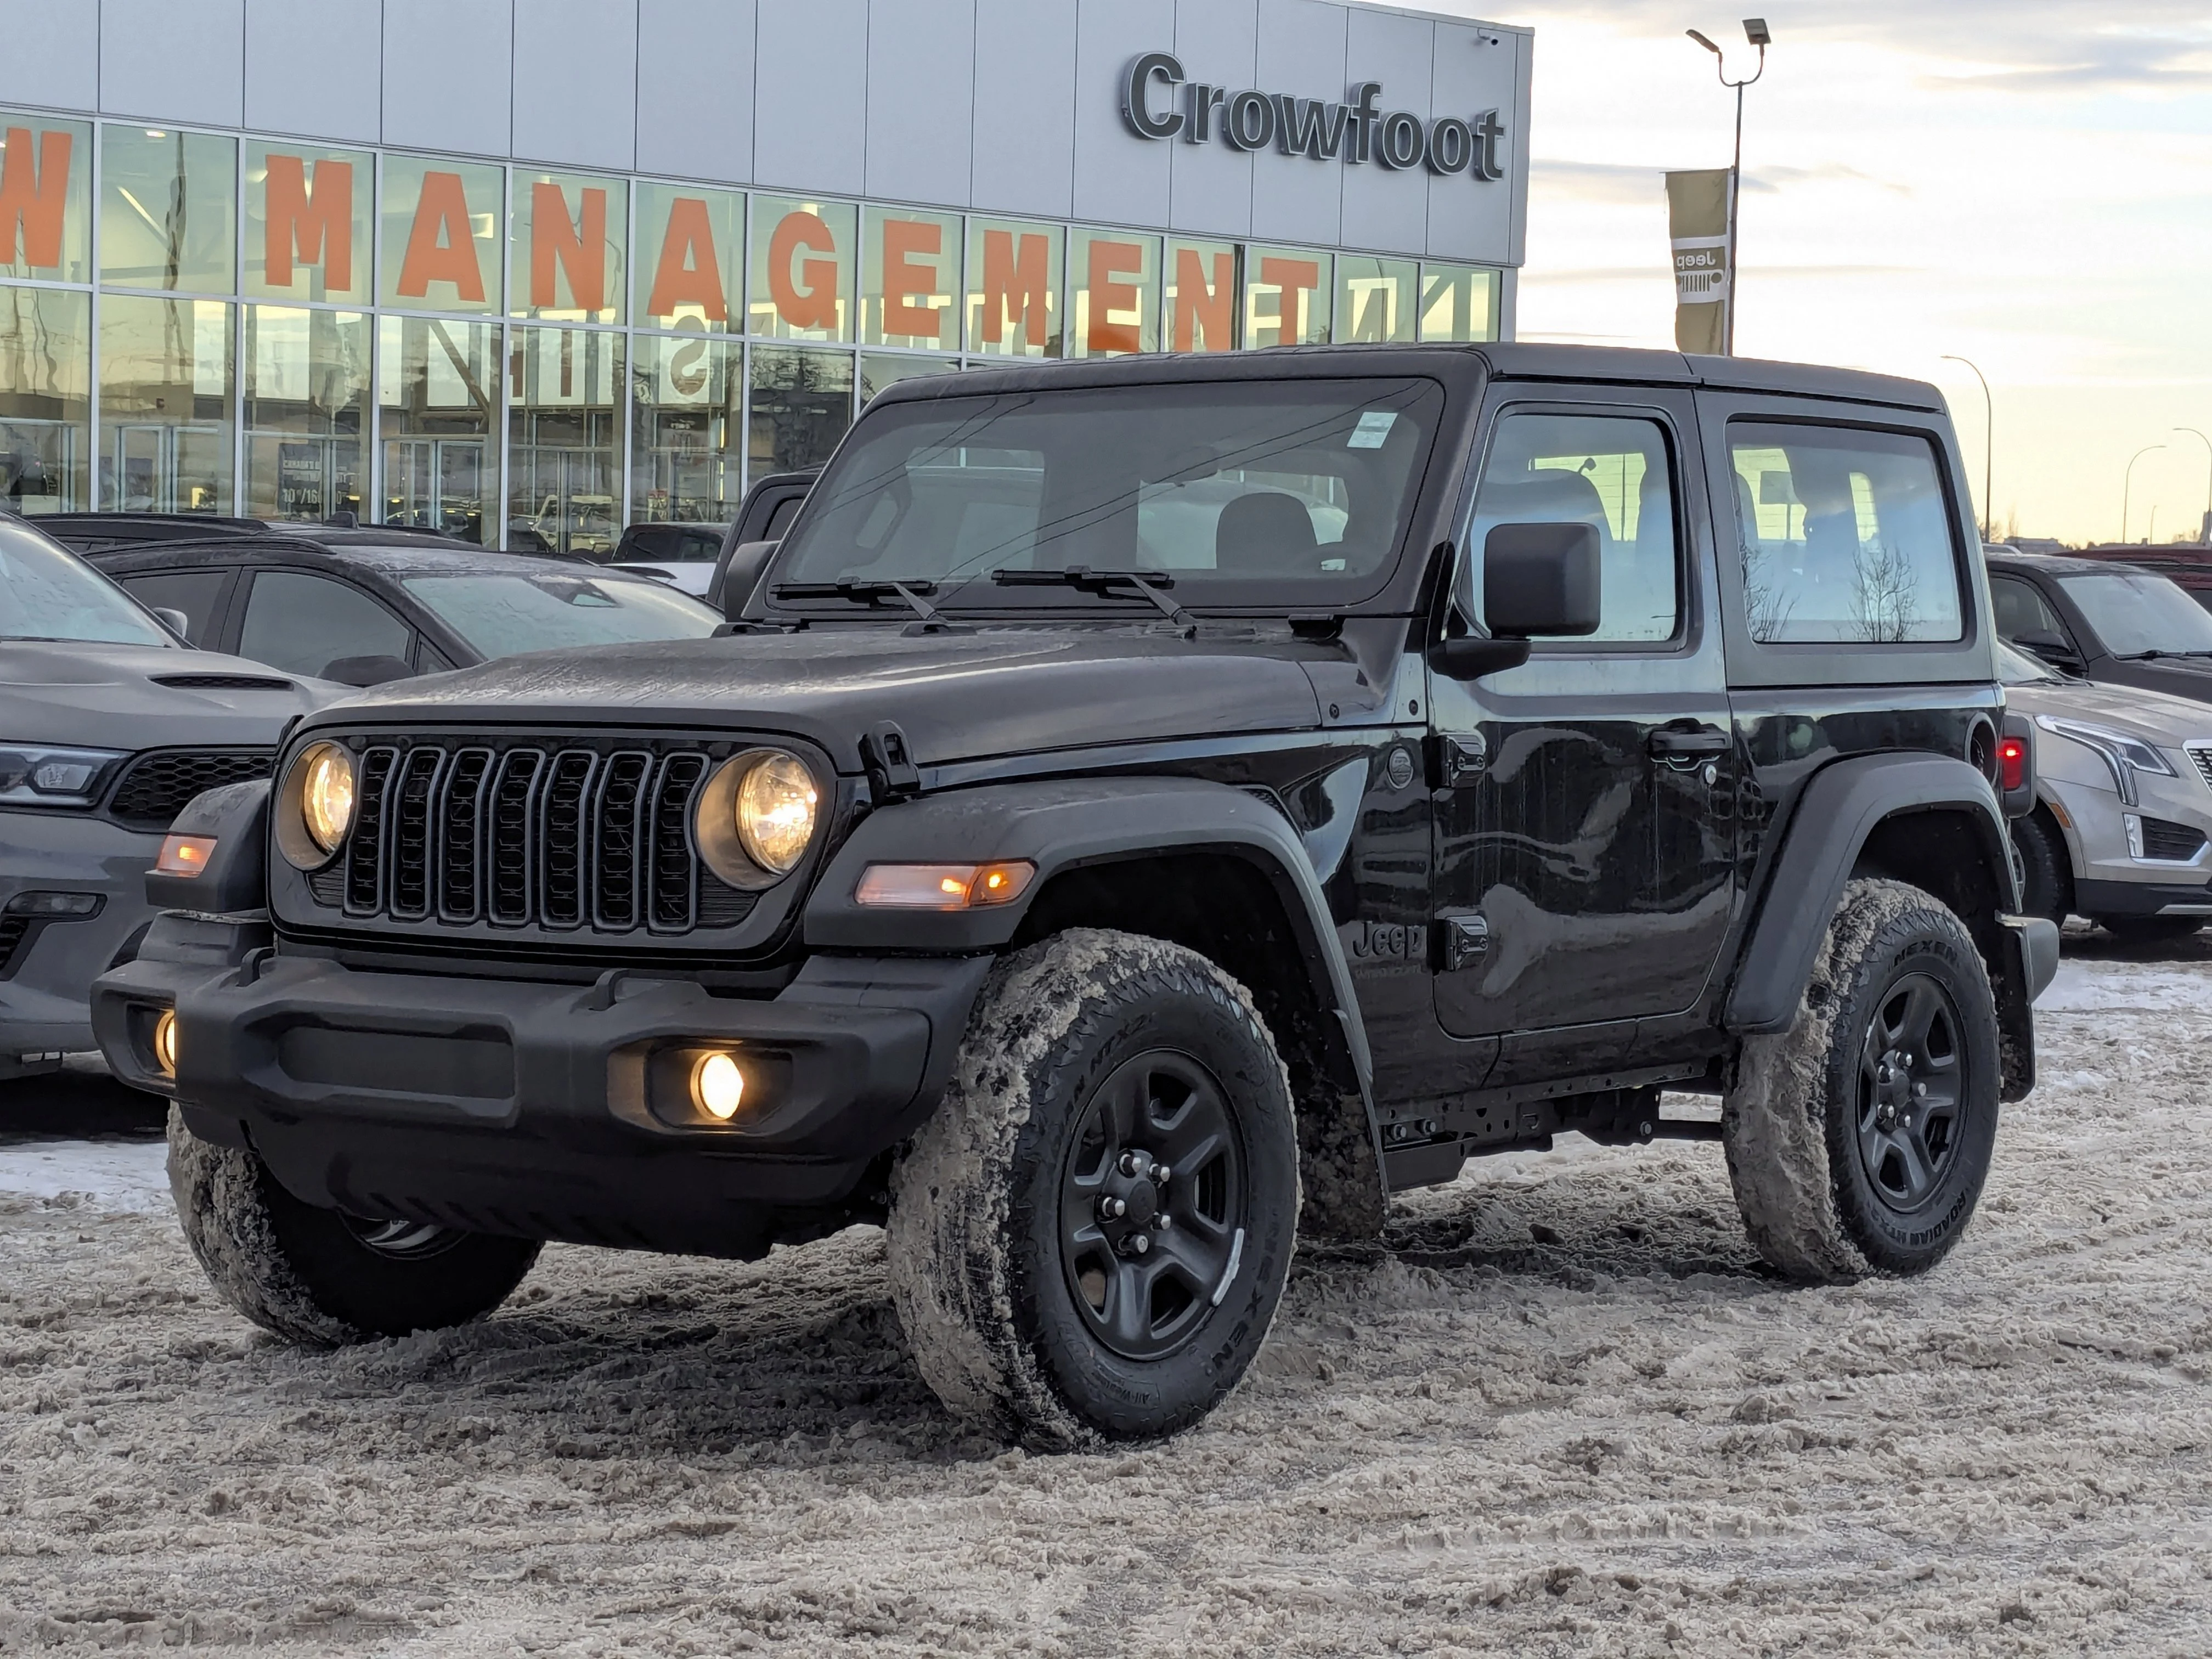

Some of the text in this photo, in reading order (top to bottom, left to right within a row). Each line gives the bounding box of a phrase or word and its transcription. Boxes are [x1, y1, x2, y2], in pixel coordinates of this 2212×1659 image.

[1122, 50, 1506, 182] Crowfoot
[266, 154, 1318, 353] MANAGEMENT
[1352, 921, 1425, 960] Jeep
[1894, 940, 1958, 967] NEXEN
[1910, 1190, 1966, 1246] ROADIAN
